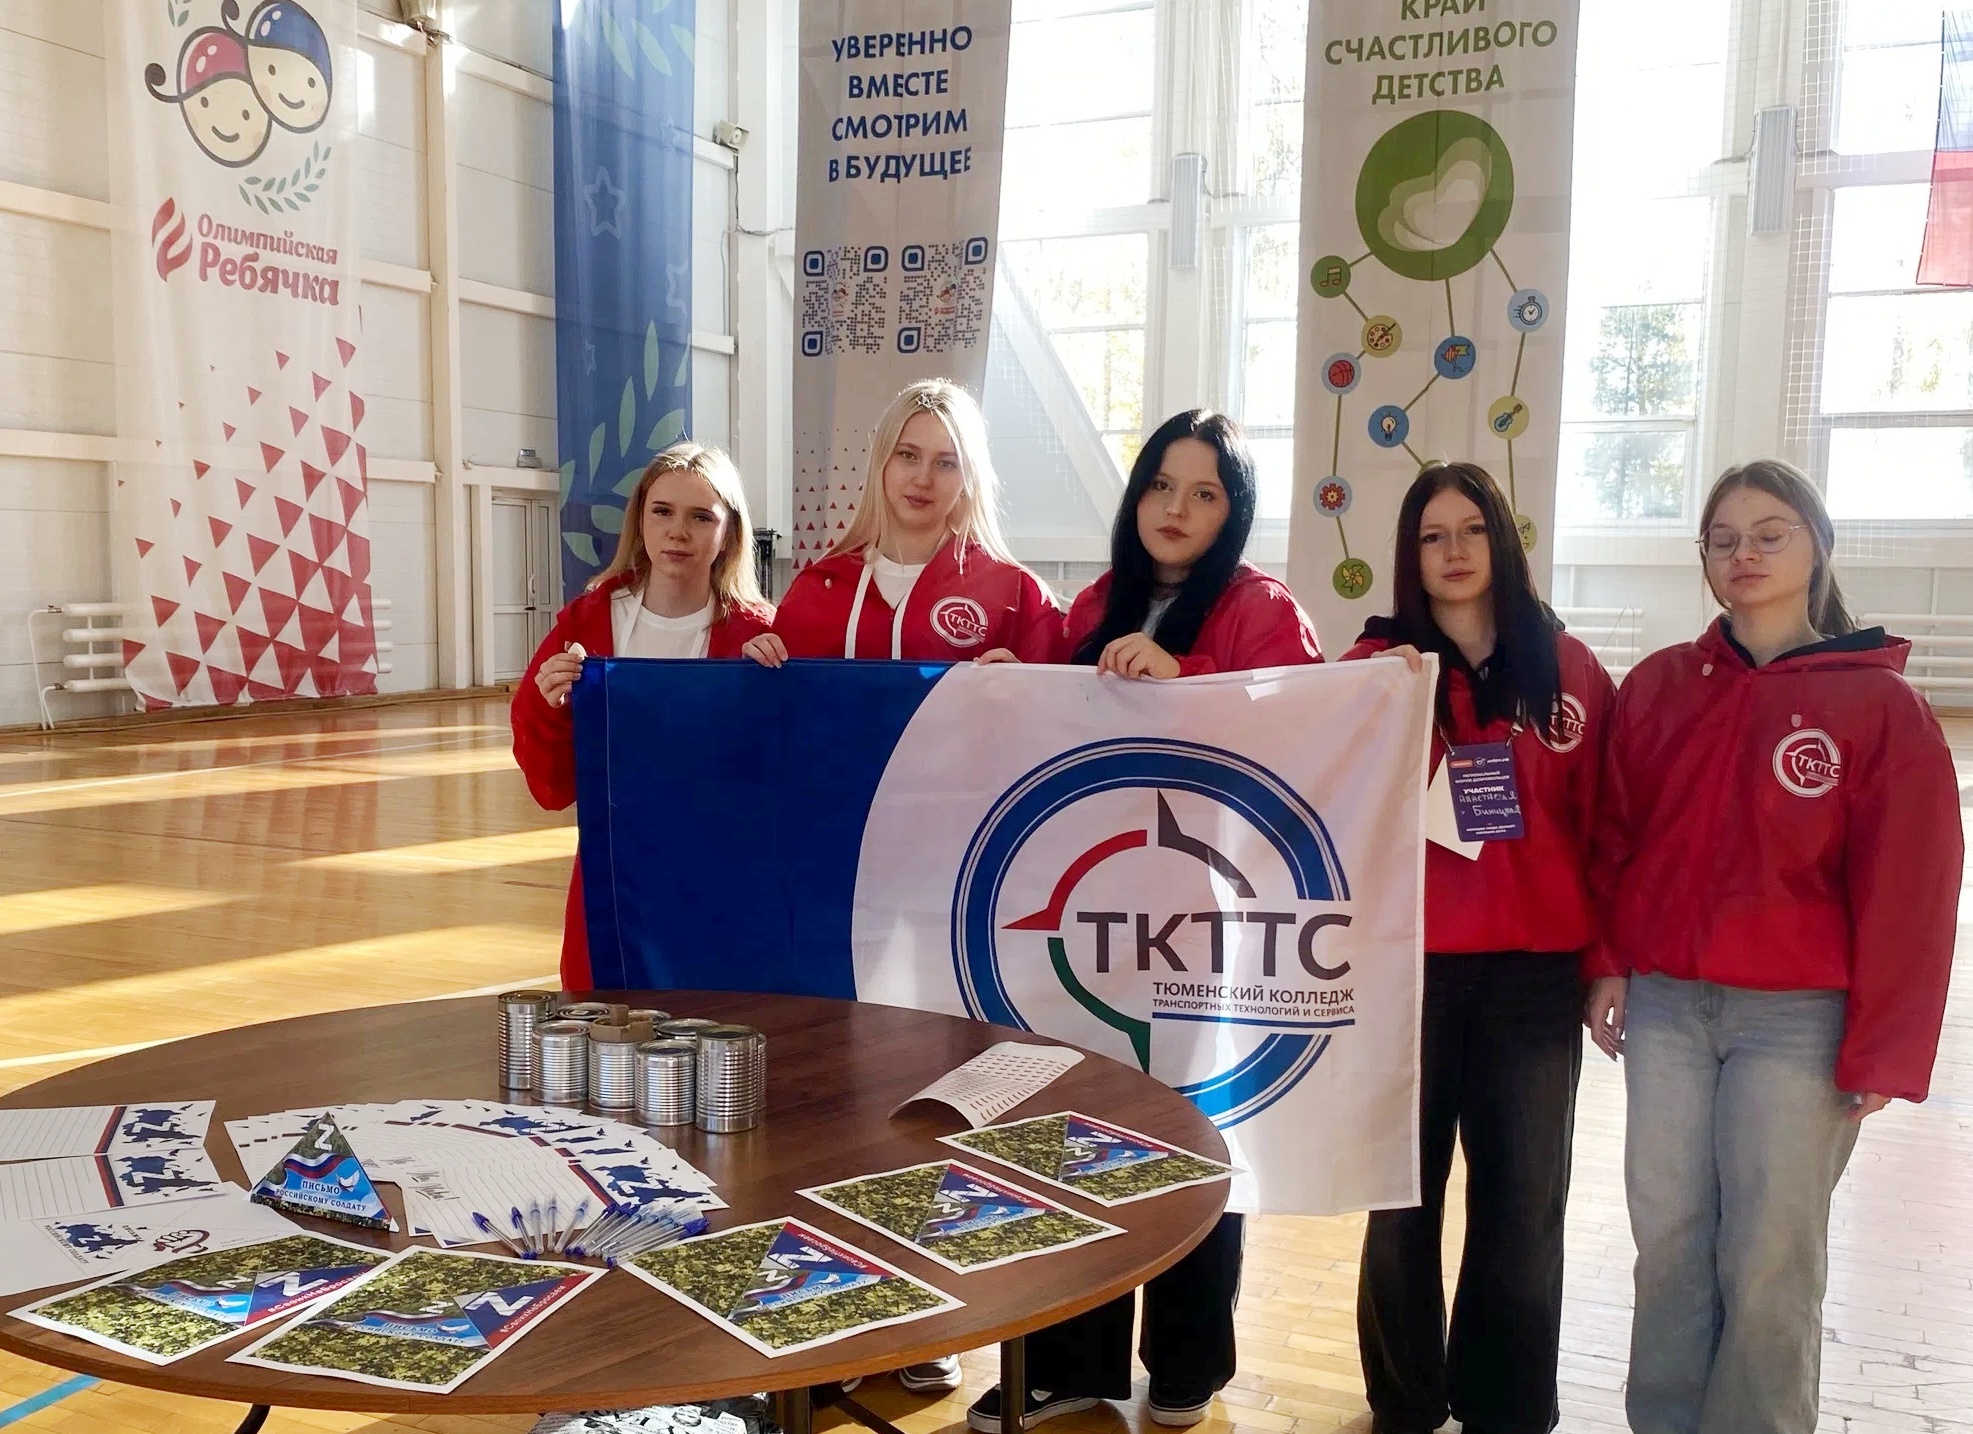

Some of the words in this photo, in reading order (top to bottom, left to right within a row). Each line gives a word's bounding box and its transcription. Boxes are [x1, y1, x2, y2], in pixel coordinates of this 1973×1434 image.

[831, 26, 972, 62] УВЕРЕННО
[1325, 20, 1557, 65] СЧАСТЛИВОГО
[848, 69, 948, 99] ВМЕСТЕ
[1371, 64, 1505, 105] ДЕТСТВА
[832, 108, 967, 141] СМОТРИМ
[828, 158, 839, 183] В
[845, 146, 972, 184] БУДУЩЕЕ
[197, 213, 338, 265] Олимпийская
[199, 241, 339, 306] Ребячка
[950, 612, 987, 637] ТКТТС
[1550, 714, 1586, 735] ТТТС
[1798, 753, 1841, 778] ТКТТС
[1463, 785, 1505, 795] УЧАСТНИК
[1076, 910, 1353, 981] ТКТТС
[1152, 982, 1265, 1002] ТЮМЕНСКИЙ
[1269, 988, 1355, 1006] КОЛЛЕДЖ
[1152, 998, 1232, 1012] ТРАНСПОРТНЫХ
[1233, 1002, 1300, 1017] ТЕХНОЛОГИЙ
[1303, 1007, 1311, 1017] И
[1313, 1005, 1355, 1017] СЕРВИСА
[314, 1123, 335, 1151] Z
[275, 1188, 329, 1205] РОССИЙСКОМУ
[330, 1199, 367, 1212] СОЛДАТУ
[302, 1180, 340, 1195] ПИСЬМО
